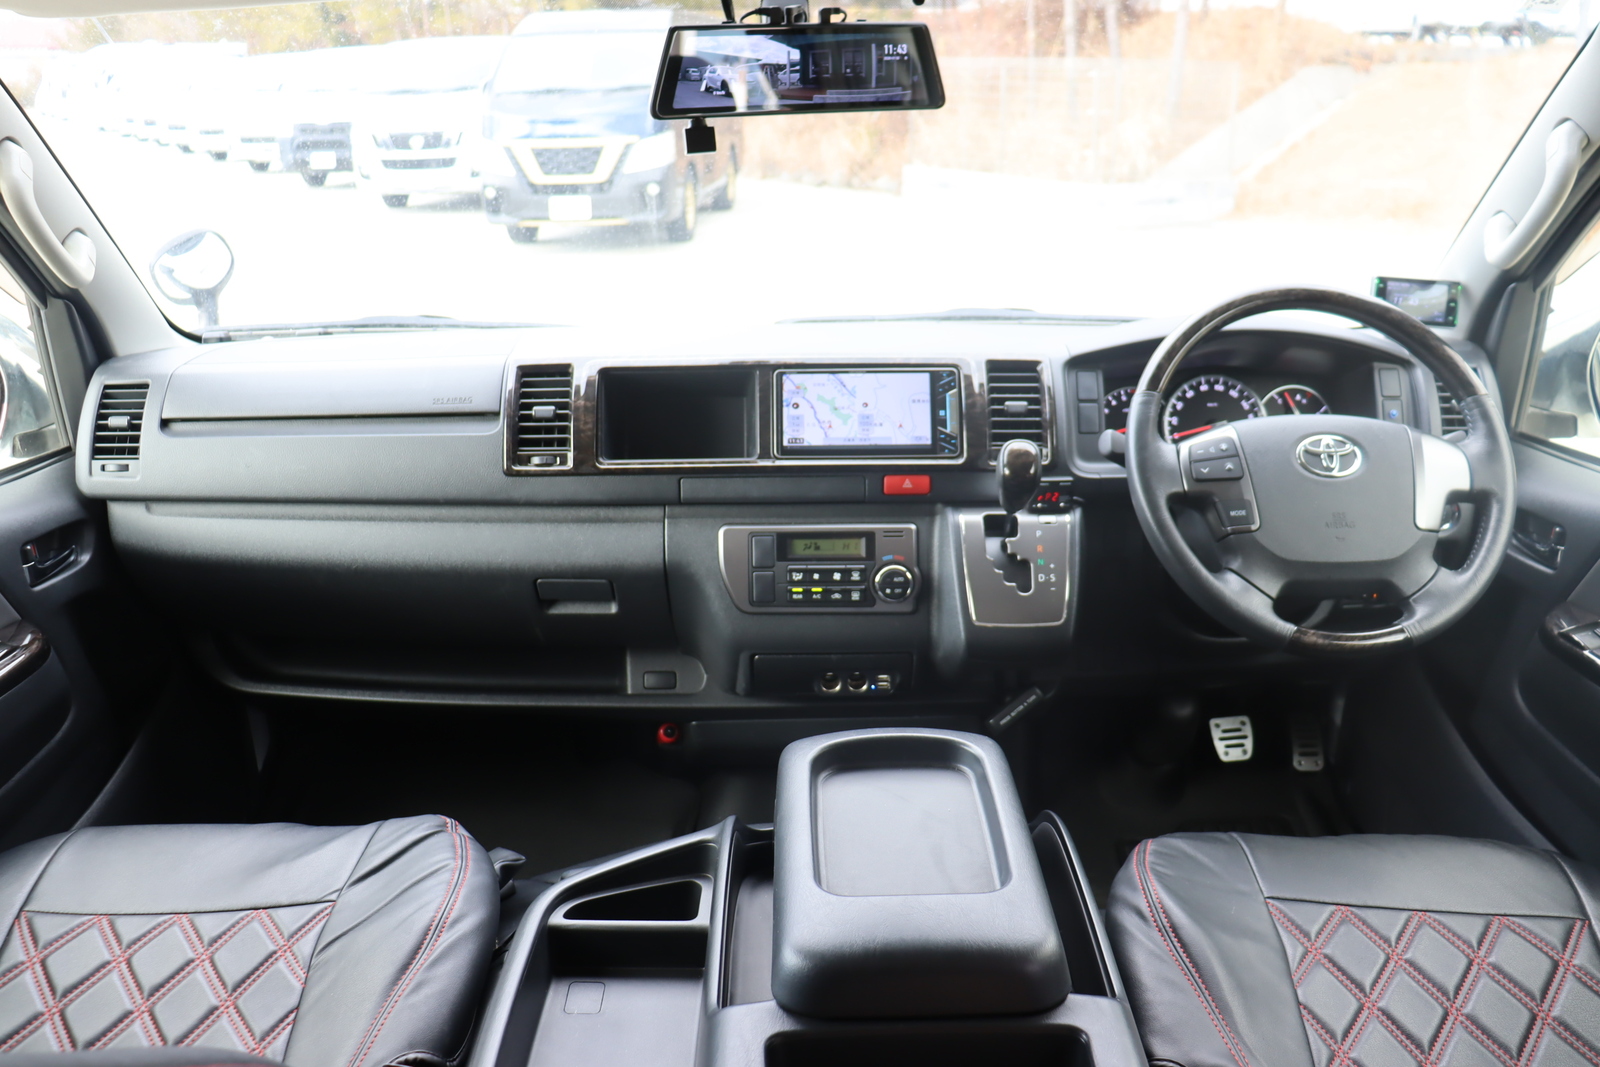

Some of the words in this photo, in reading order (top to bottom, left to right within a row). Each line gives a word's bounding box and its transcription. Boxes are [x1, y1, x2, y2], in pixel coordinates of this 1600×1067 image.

[884, 44, 908, 55] 11:43
[1036, 530, 1042, 538] P
[1036, 545, 1043, 553] R
[1037, 558, 1045, 566] N
